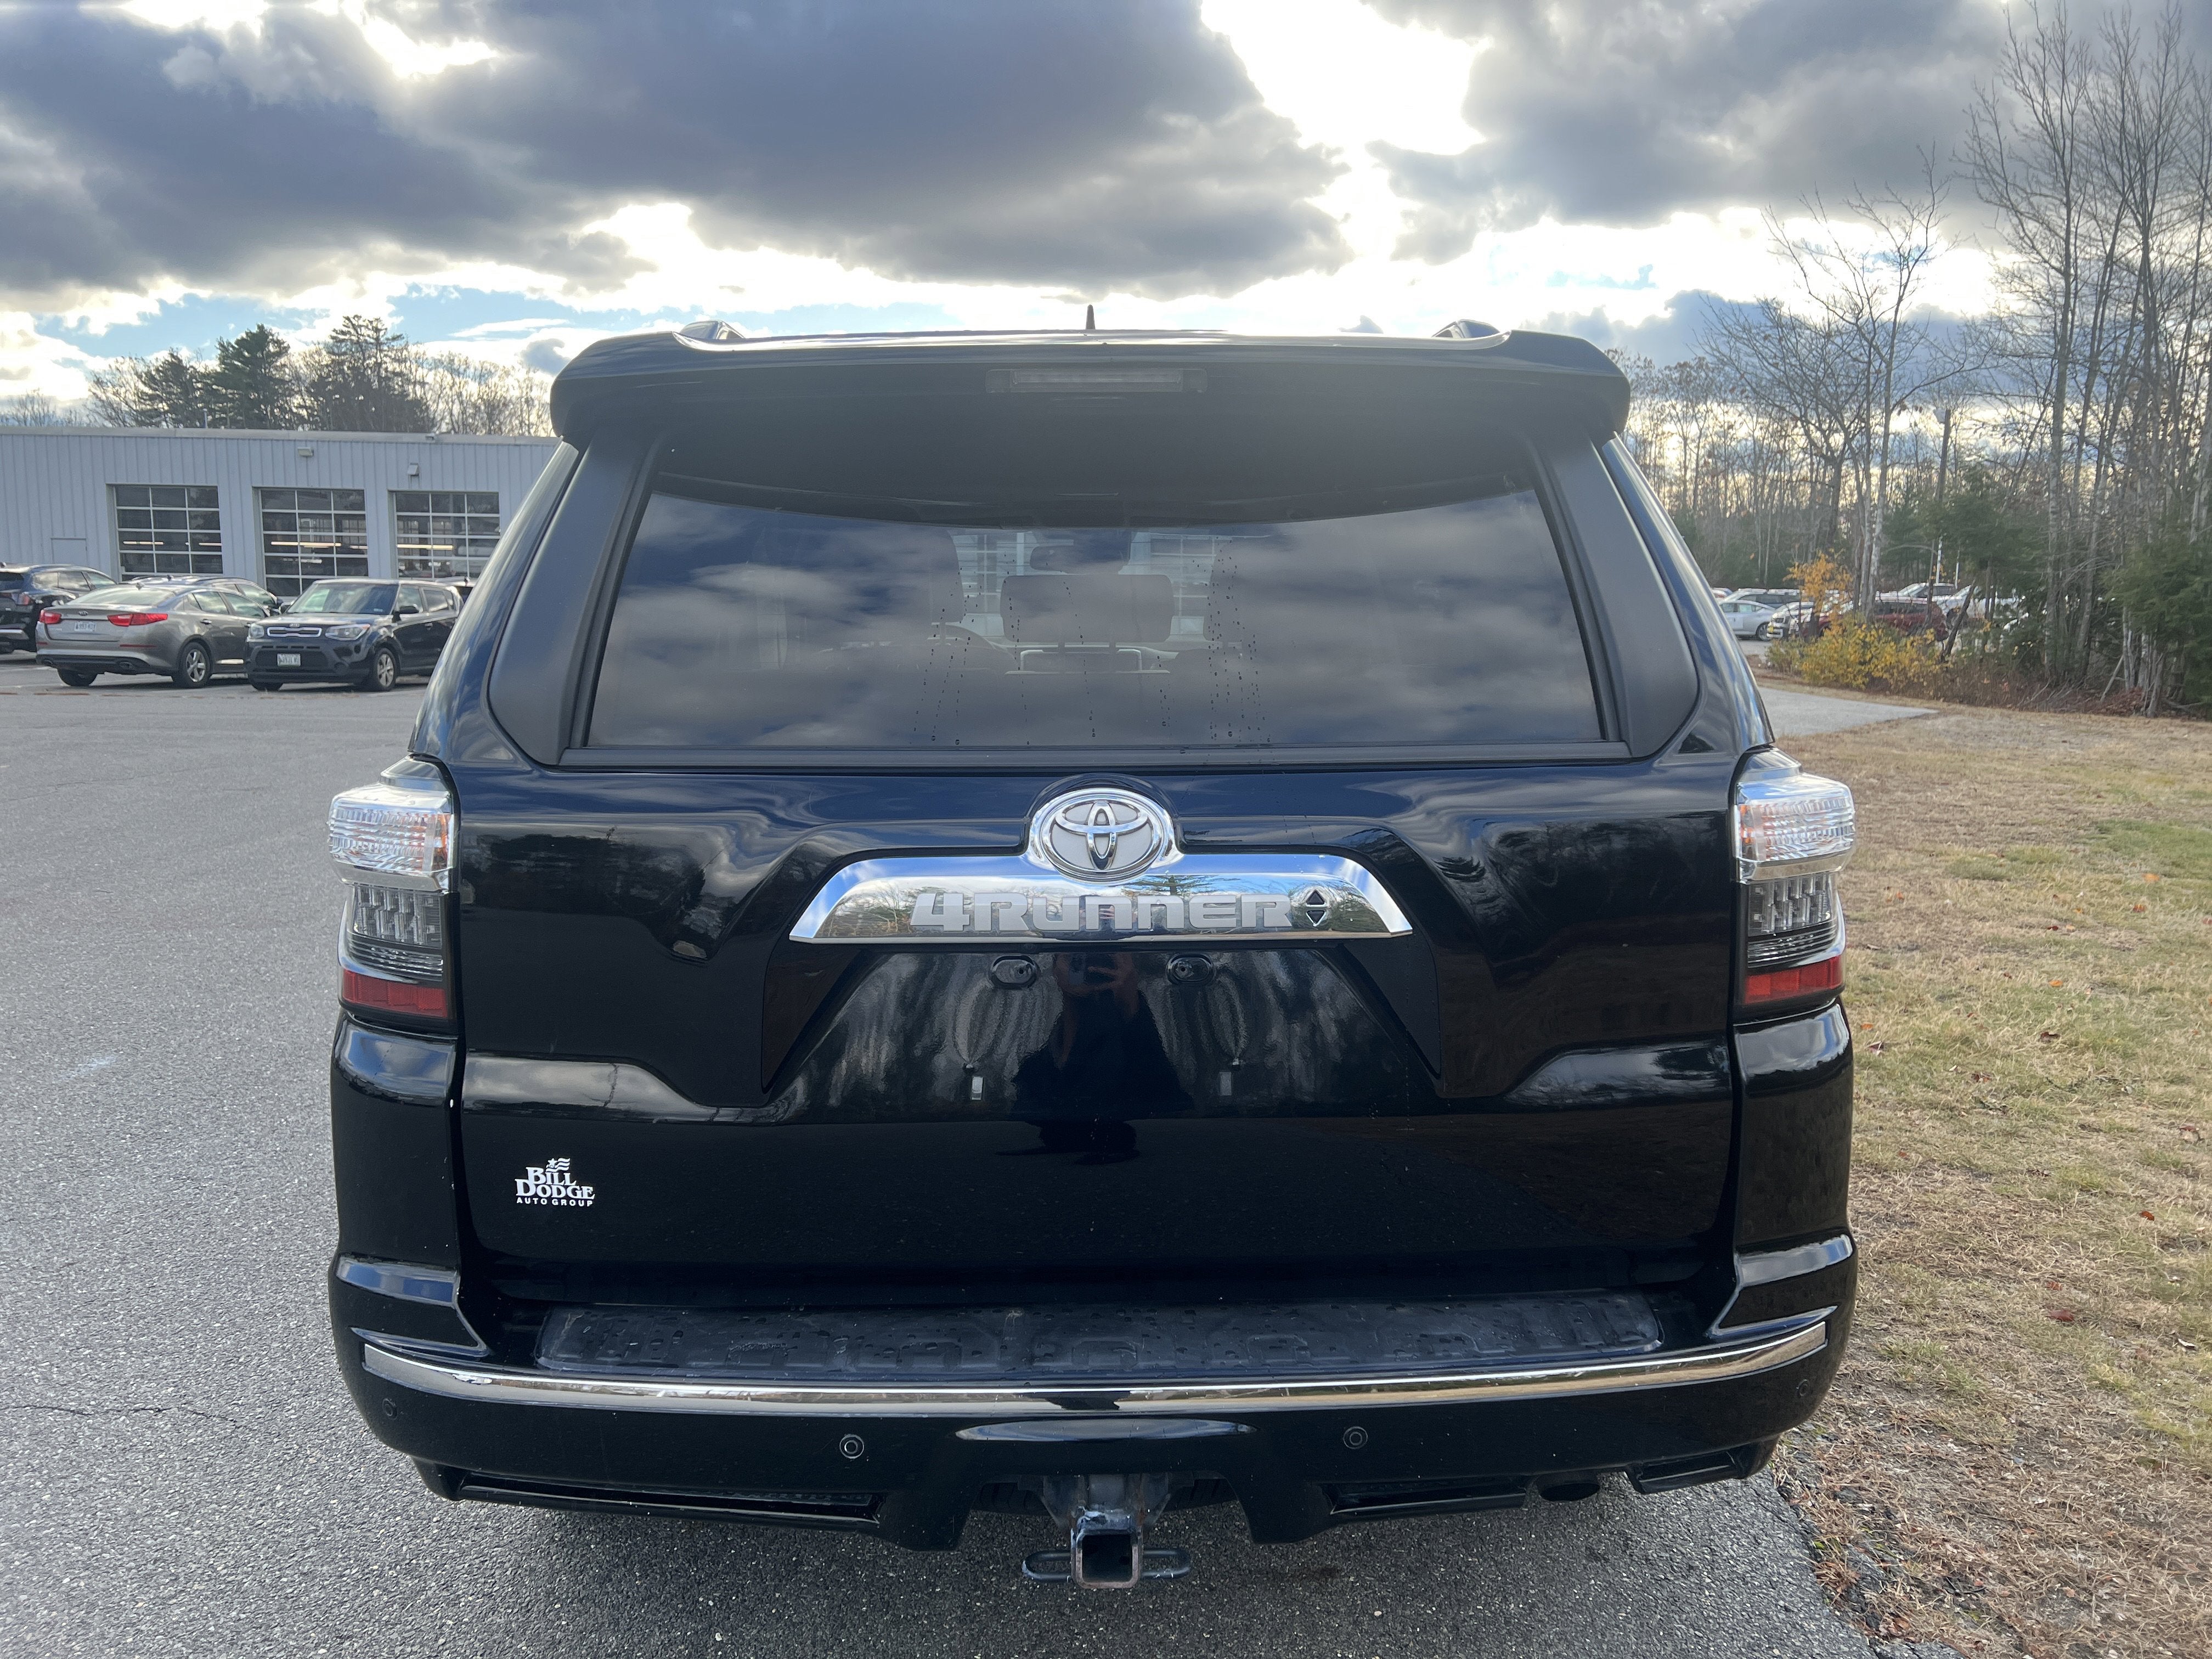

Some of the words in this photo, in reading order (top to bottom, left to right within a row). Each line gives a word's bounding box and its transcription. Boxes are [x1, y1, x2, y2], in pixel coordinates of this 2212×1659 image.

[526, 1167, 577, 1186] BILL
[515, 1179, 595, 1199] DODGE
[552, 1199, 593, 1207] GROUP
